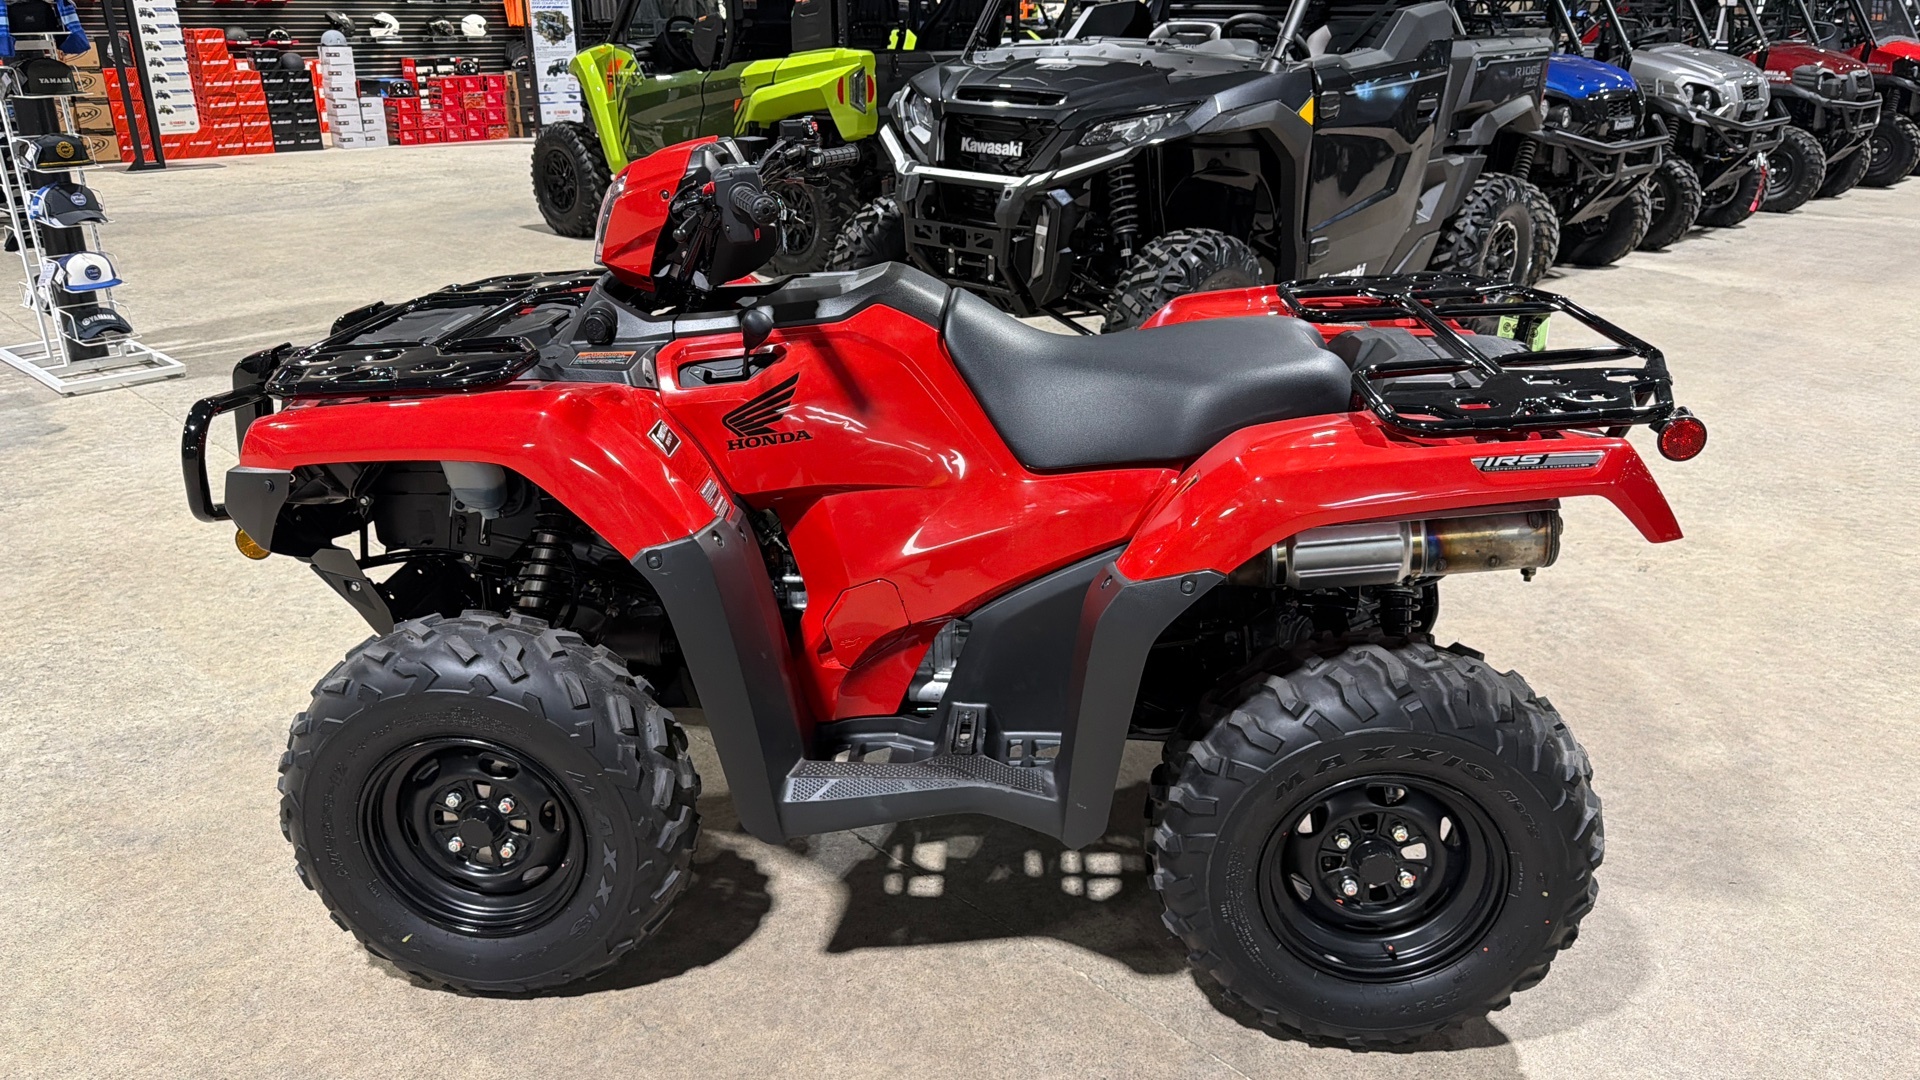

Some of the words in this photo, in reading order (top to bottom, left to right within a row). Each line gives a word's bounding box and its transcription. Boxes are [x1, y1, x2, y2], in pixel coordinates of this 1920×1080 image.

[961, 137, 1023, 157] Kawasaki
[727, 430, 813, 450] HONDA
[1484, 455, 1545, 467] IRS
[1275, 745, 1495, 800] MAXXIS
